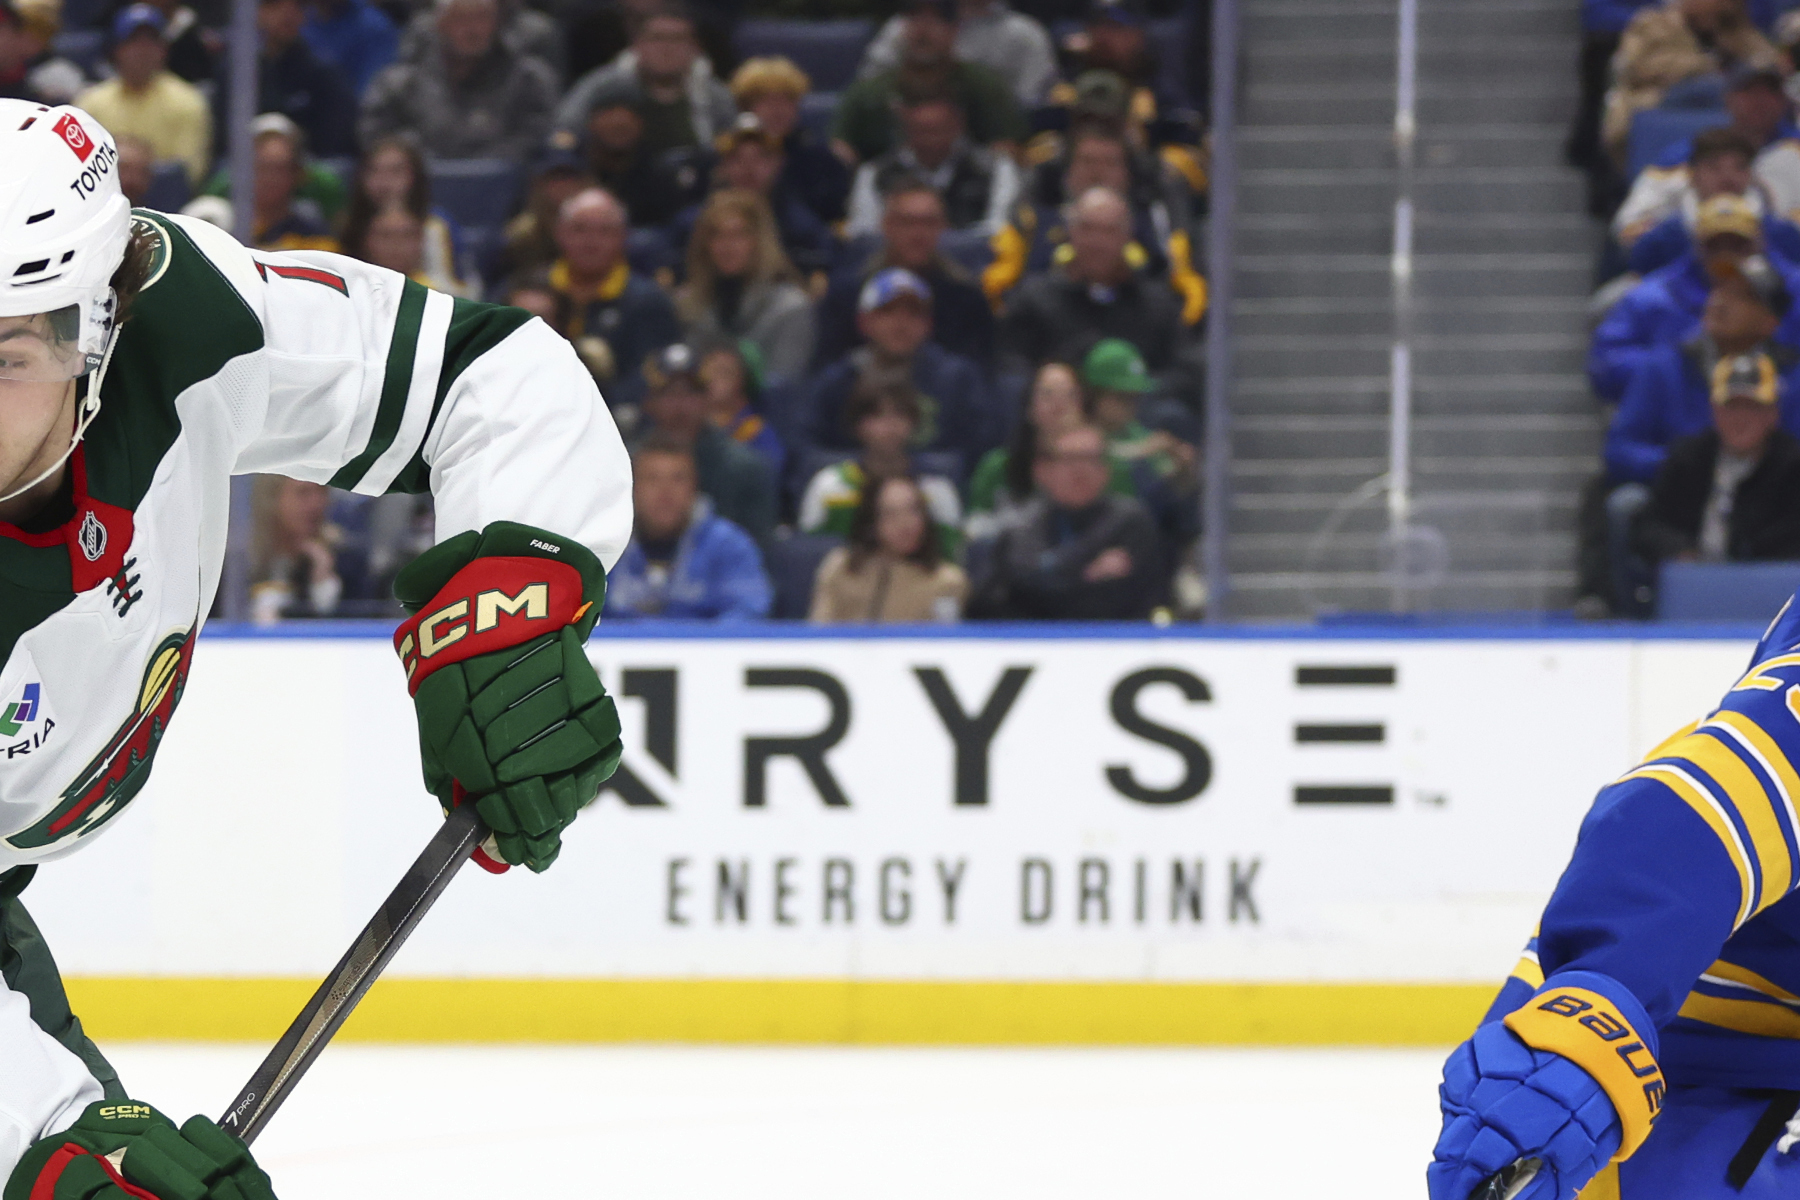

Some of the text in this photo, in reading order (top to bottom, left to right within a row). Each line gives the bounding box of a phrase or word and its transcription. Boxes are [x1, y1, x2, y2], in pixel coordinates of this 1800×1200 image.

[70, 142, 117, 200] TOYOTA
[530, 538, 561, 554] FABER
[399, 582, 549, 681] CCM
[744, 665, 1397, 807] RYSE
[666, 858, 1263, 926] ENERGY DRINK
[100, 1105, 150, 1115] CCM
